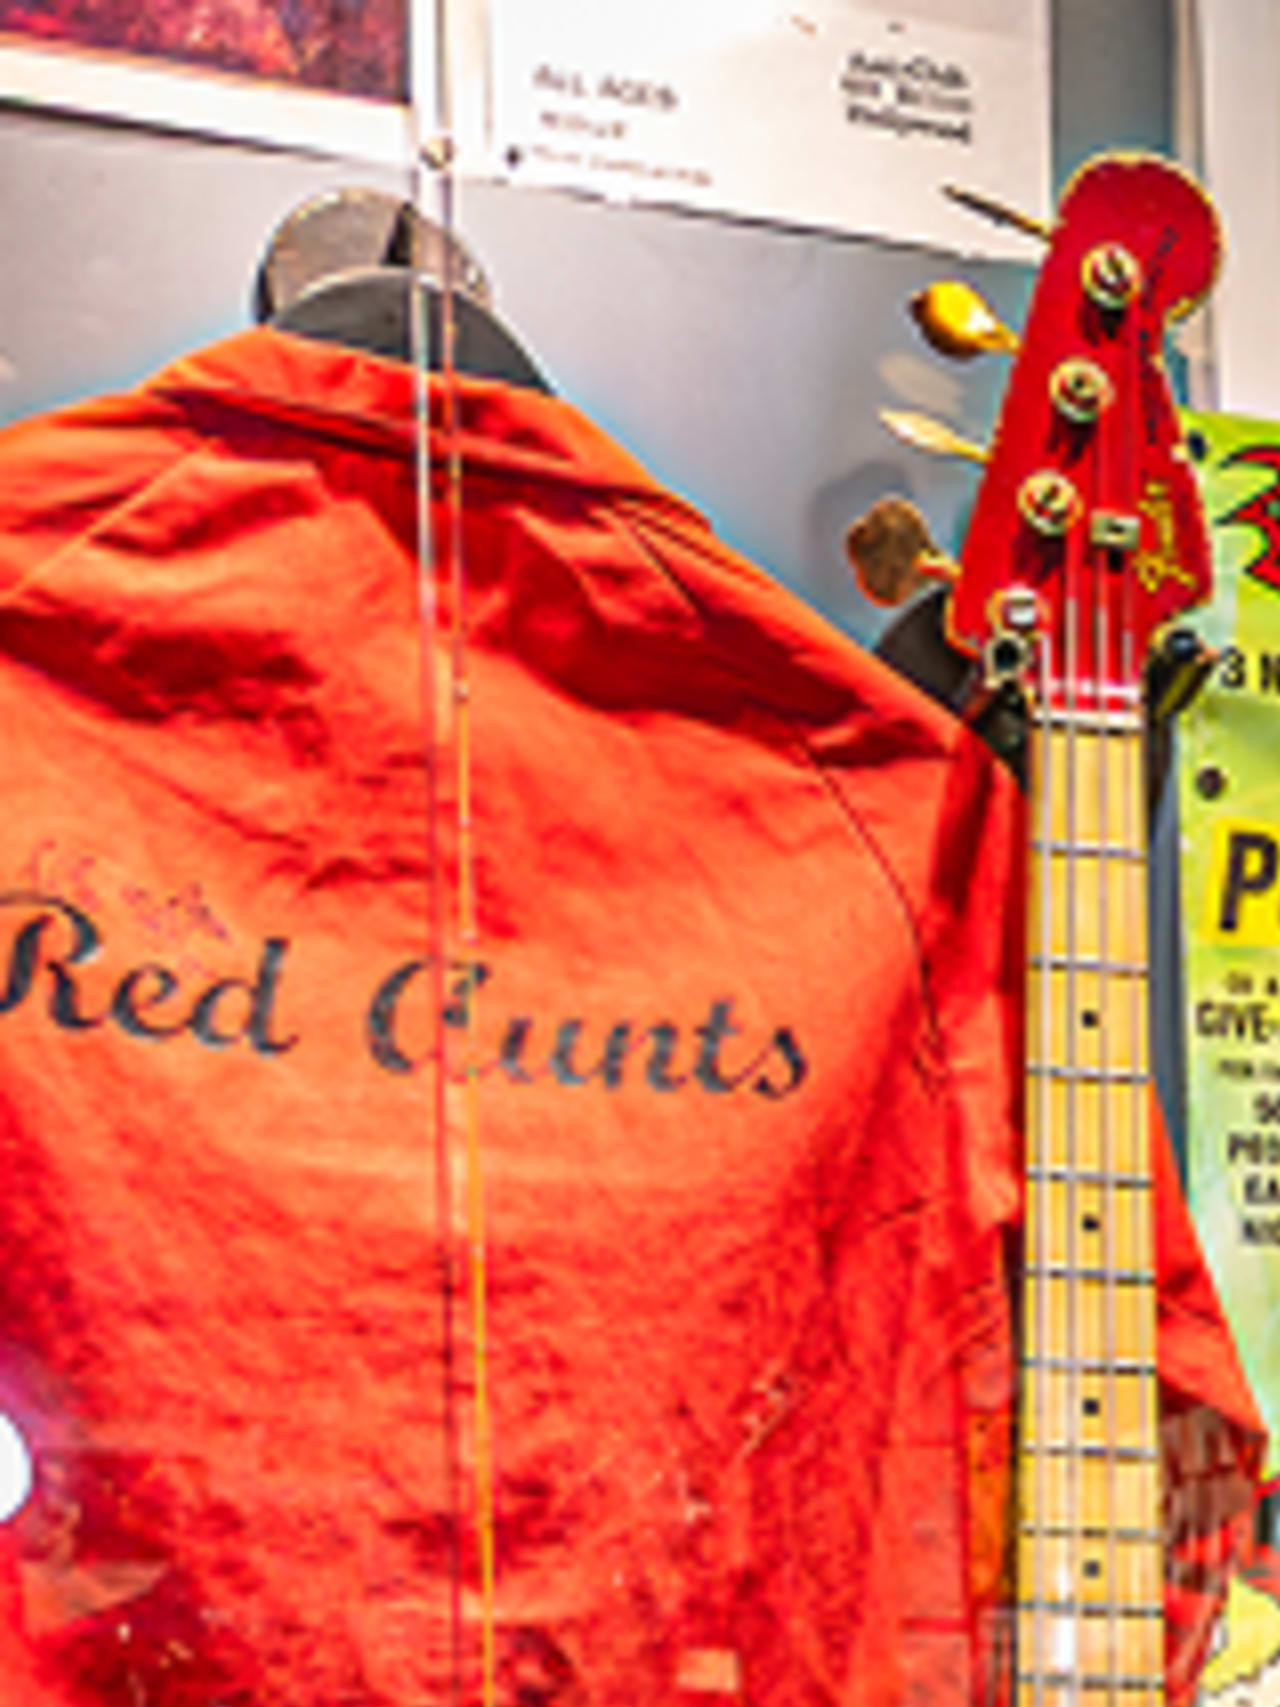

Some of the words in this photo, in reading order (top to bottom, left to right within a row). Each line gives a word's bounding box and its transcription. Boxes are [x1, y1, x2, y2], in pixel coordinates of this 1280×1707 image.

[1222, 649, 1247, 689] 3
[0, 890, 301, 1060] Red
[366, 954, 810, 1102] Aunts
